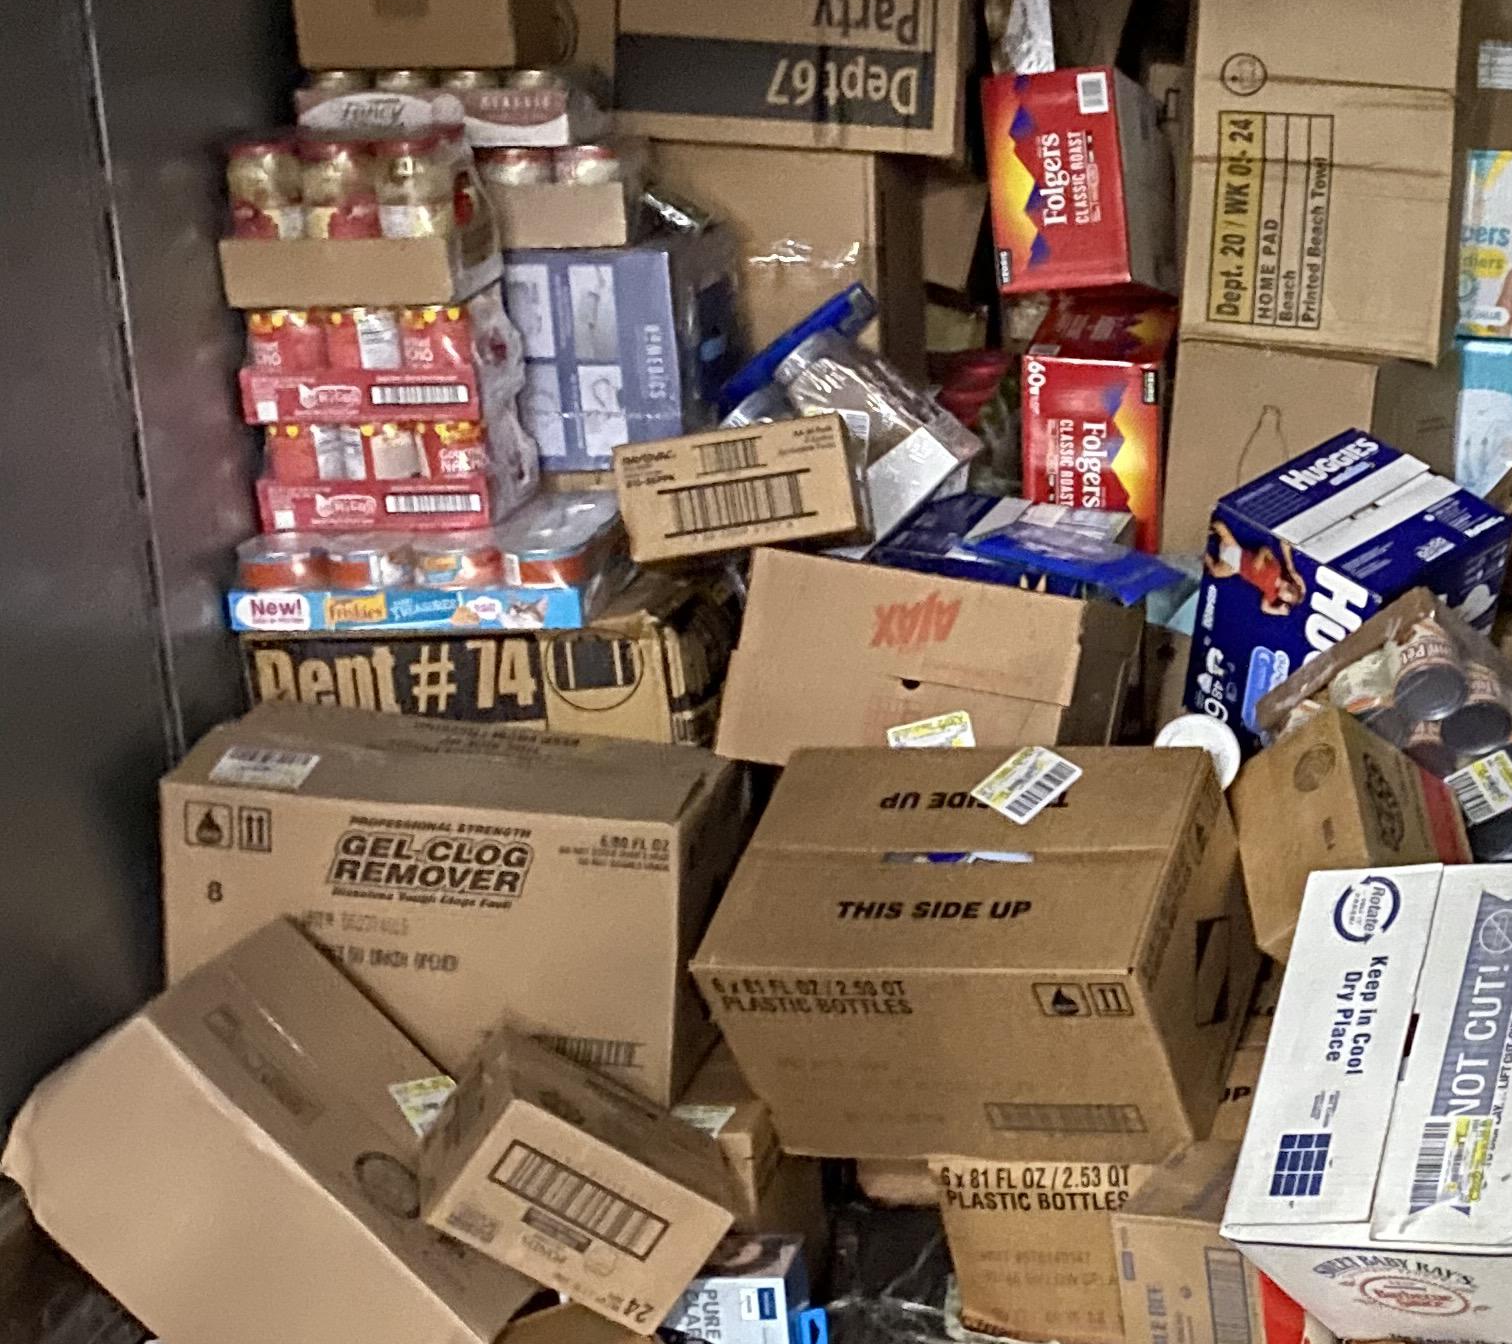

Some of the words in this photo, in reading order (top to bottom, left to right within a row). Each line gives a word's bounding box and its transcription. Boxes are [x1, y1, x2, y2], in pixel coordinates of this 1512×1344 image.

[1066, 131, 1084, 170] ROAST
[1039, 132, 1070, 226] Folgers
[1224, 181, 1251, 216] WK
[1071, 173, 1090, 225] CLASSIC
[1221, 233, 1246, 258] 20
[1266, 218, 1279, 256] PAD
[1306, 205, 1327, 258] Beach
[1216, 262, 1246, 317] Dept.
[1257, 263, 1276, 320] HOME
[1279, 270, 1296, 322] Beach
[1302, 263, 1318, 323] Printed
[1060, 419, 1075, 467] CLASSIC
[1076, 419, 1107, 508] Folgers
[1060, 471, 1074, 507] ROAST
[250, 598, 302, 617] New!
[466, 638, 536, 710] 74
[880, 792, 921, 809] UP
[351, 816, 452, 834] PROFESSIONAL
[456, 823, 532, 839] STRENGTH
[333, 860, 521, 894] REMOVER
[838, 901, 902, 919] THIS
[911, 902, 982, 919] SIDE
[990, 901, 1032, 919] UP
[1364, 886, 1386, 931] Rotate
[769, 980, 792, 996] FL
[1337, 971, 1363, 1001] Dry
[1361, 955, 1388, 1001] Keep
[722, 996, 811, 1014] PLASTIC
[815, 996, 913, 1015] BOTTLES
[1356, 1008, 1377, 1025] in
[1464, 964, 1510, 1041] CUT!
[1325, 1008, 1354, 1062] Place
[1345, 1033, 1371, 1075] Cool
[1447, 1053, 1489, 1116] NOT
[1498, 1064, 1510, 1089] LIFT
[941, 1166, 951, 1187] 6
[970, 1168, 989, 1187] 81
[996, 1168, 1017, 1189] FL
[1022, 1167, 1046, 1189] OZ
[1063, 1165, 1101, 1187] 2.53
[1107, 1164, 1130, 1187] QT
[947, 1190, 1031, 1211] PLASTIC
[1038, 1190, 1129, 1211] BOTTLES
[623, 1297, 653, 1323] 24
[702, 1289, 722, 1340] PURE
